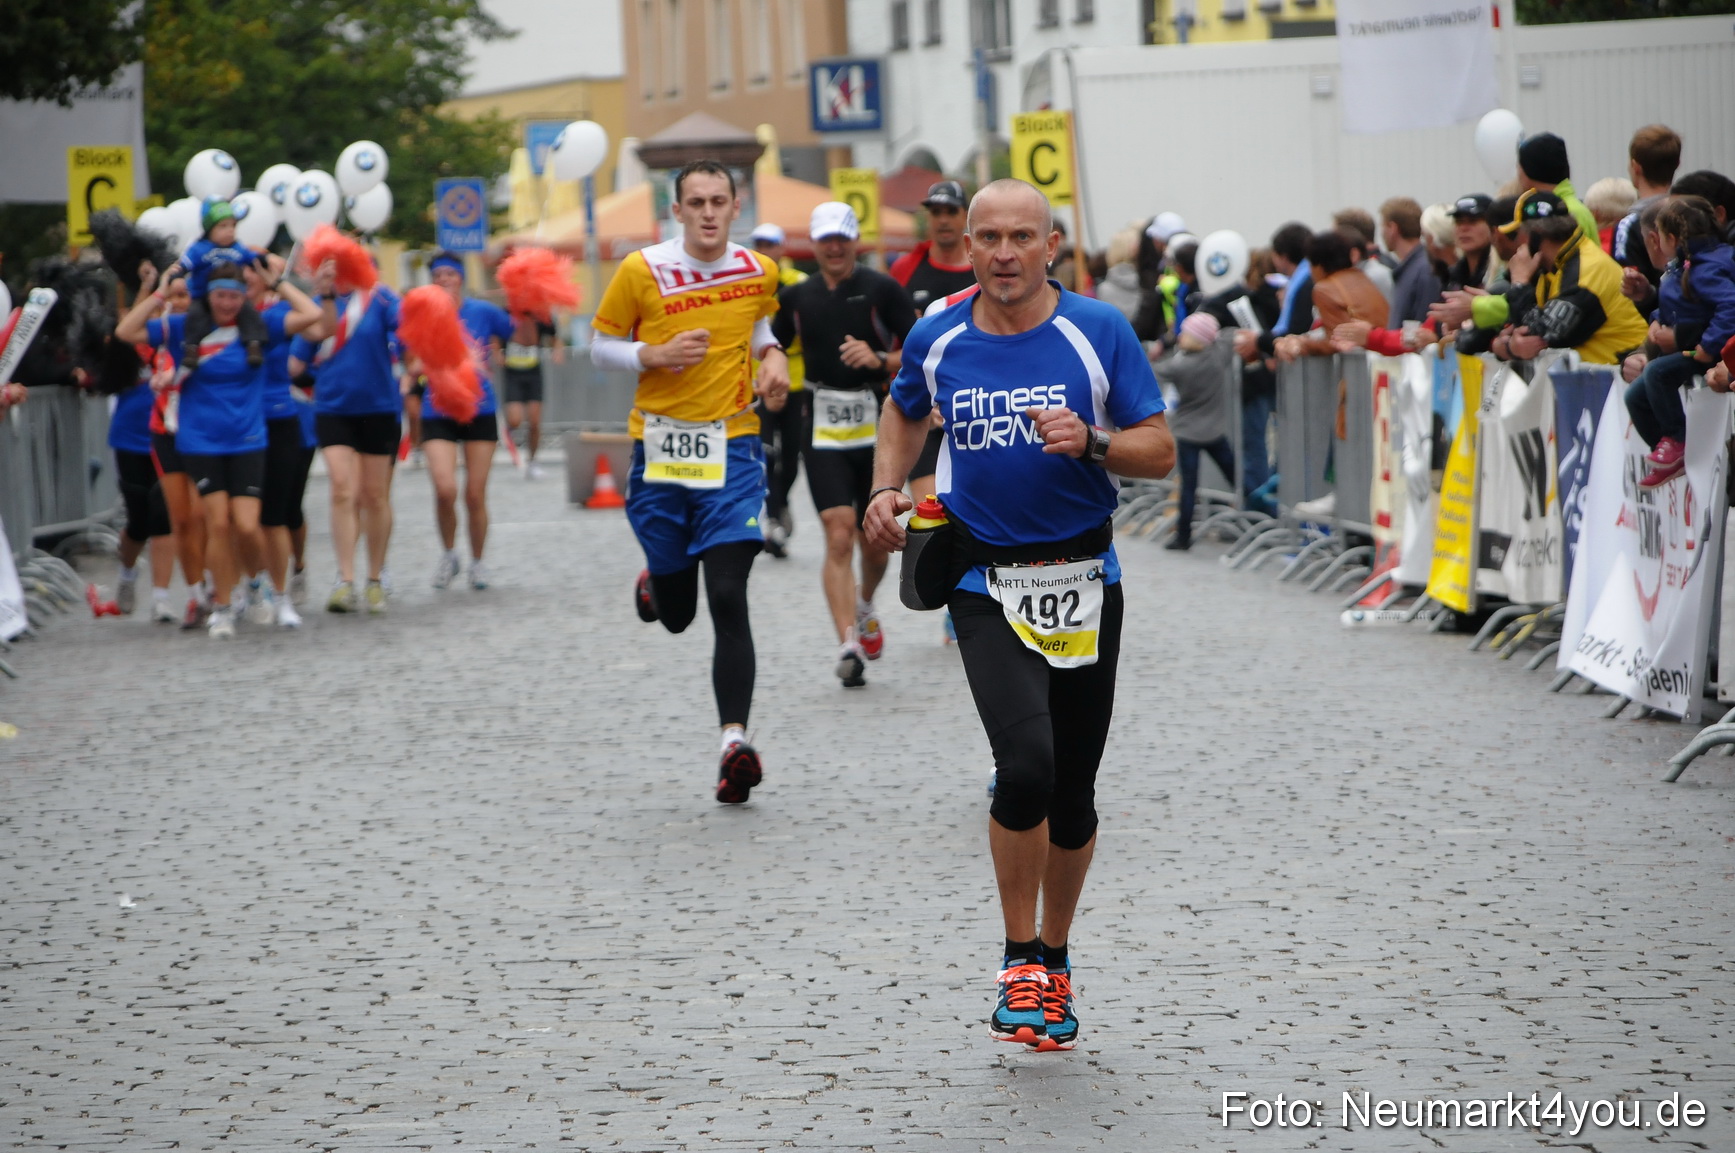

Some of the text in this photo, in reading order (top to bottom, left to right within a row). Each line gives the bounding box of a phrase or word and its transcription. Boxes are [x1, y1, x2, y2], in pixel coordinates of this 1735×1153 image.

[1015, 116, 1064, 133] Block
[74, 148, 127, 166] Block
[1029, 142, 1058, 186] C
[664, 295, 713, 316] MAX
[826, 404, 865, 424] 540
[952, 384, 1067, 421] Fitness
[952, 413, 1046, 450] CORN
[662, 432, 709, 459] 486
[664, 465, 705, 477] Thomas
[1031, 573, 1083, 588] Neumarkt
[1016, 589, 1083, 630] 492
[1576, 633, 1625, 668] arkt
